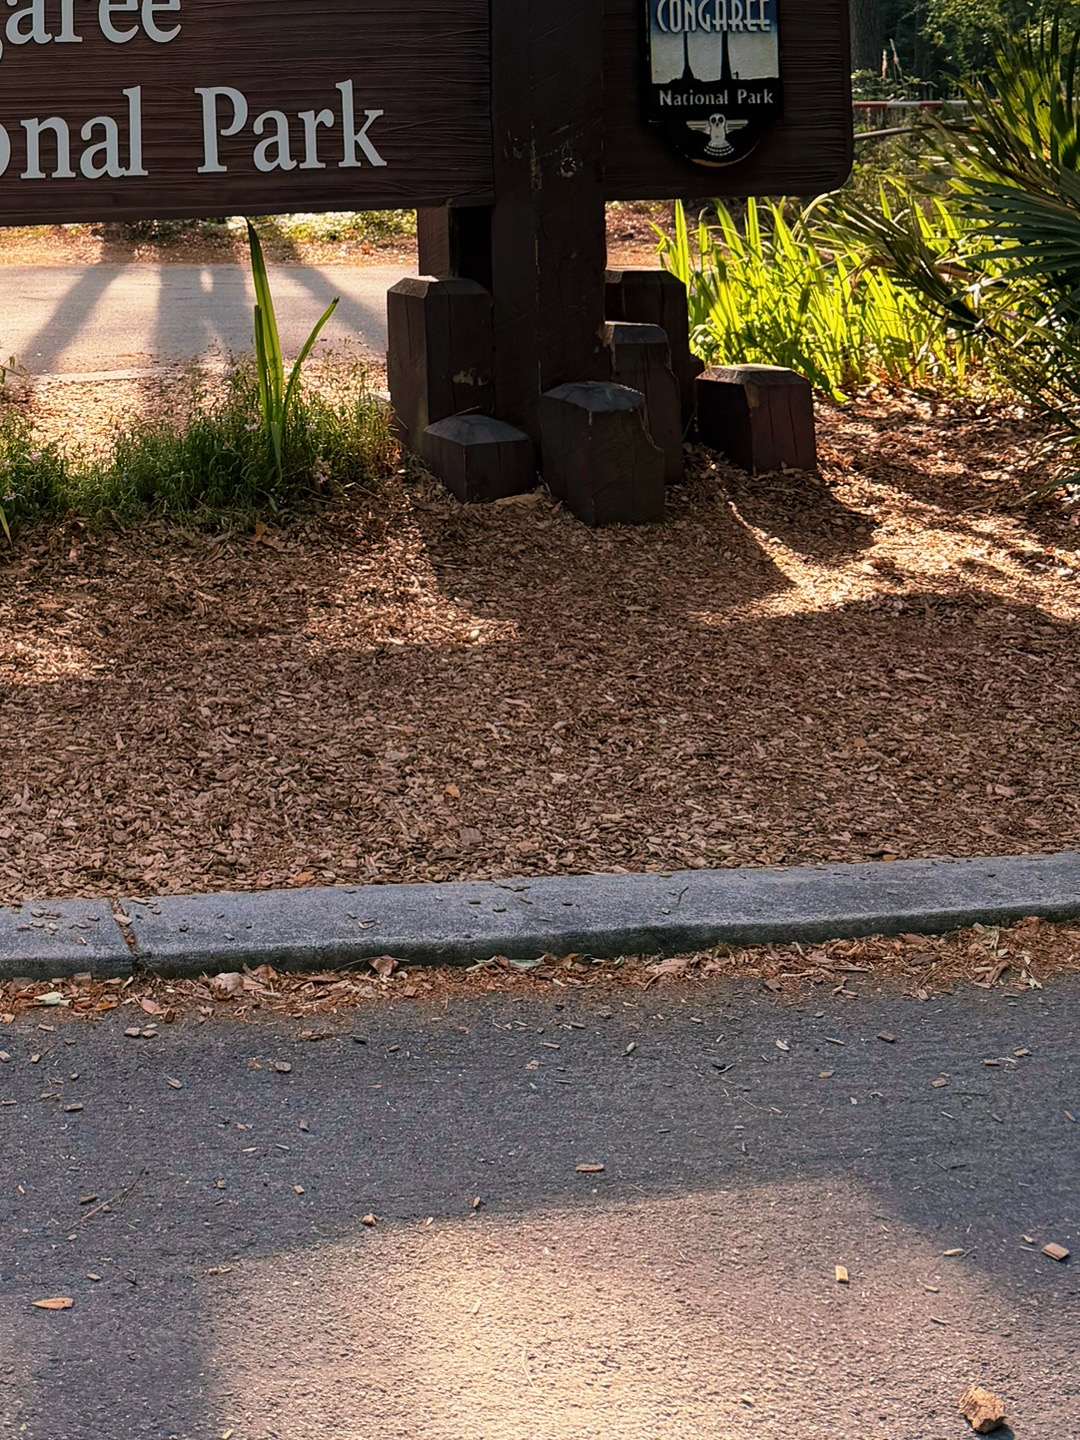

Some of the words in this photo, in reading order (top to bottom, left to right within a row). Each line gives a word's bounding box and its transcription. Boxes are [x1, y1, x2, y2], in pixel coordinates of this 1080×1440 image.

[659, 90, 728, 106] National
[738, 89, 773, 104] Park
[195, 79, 387, 173] Park
